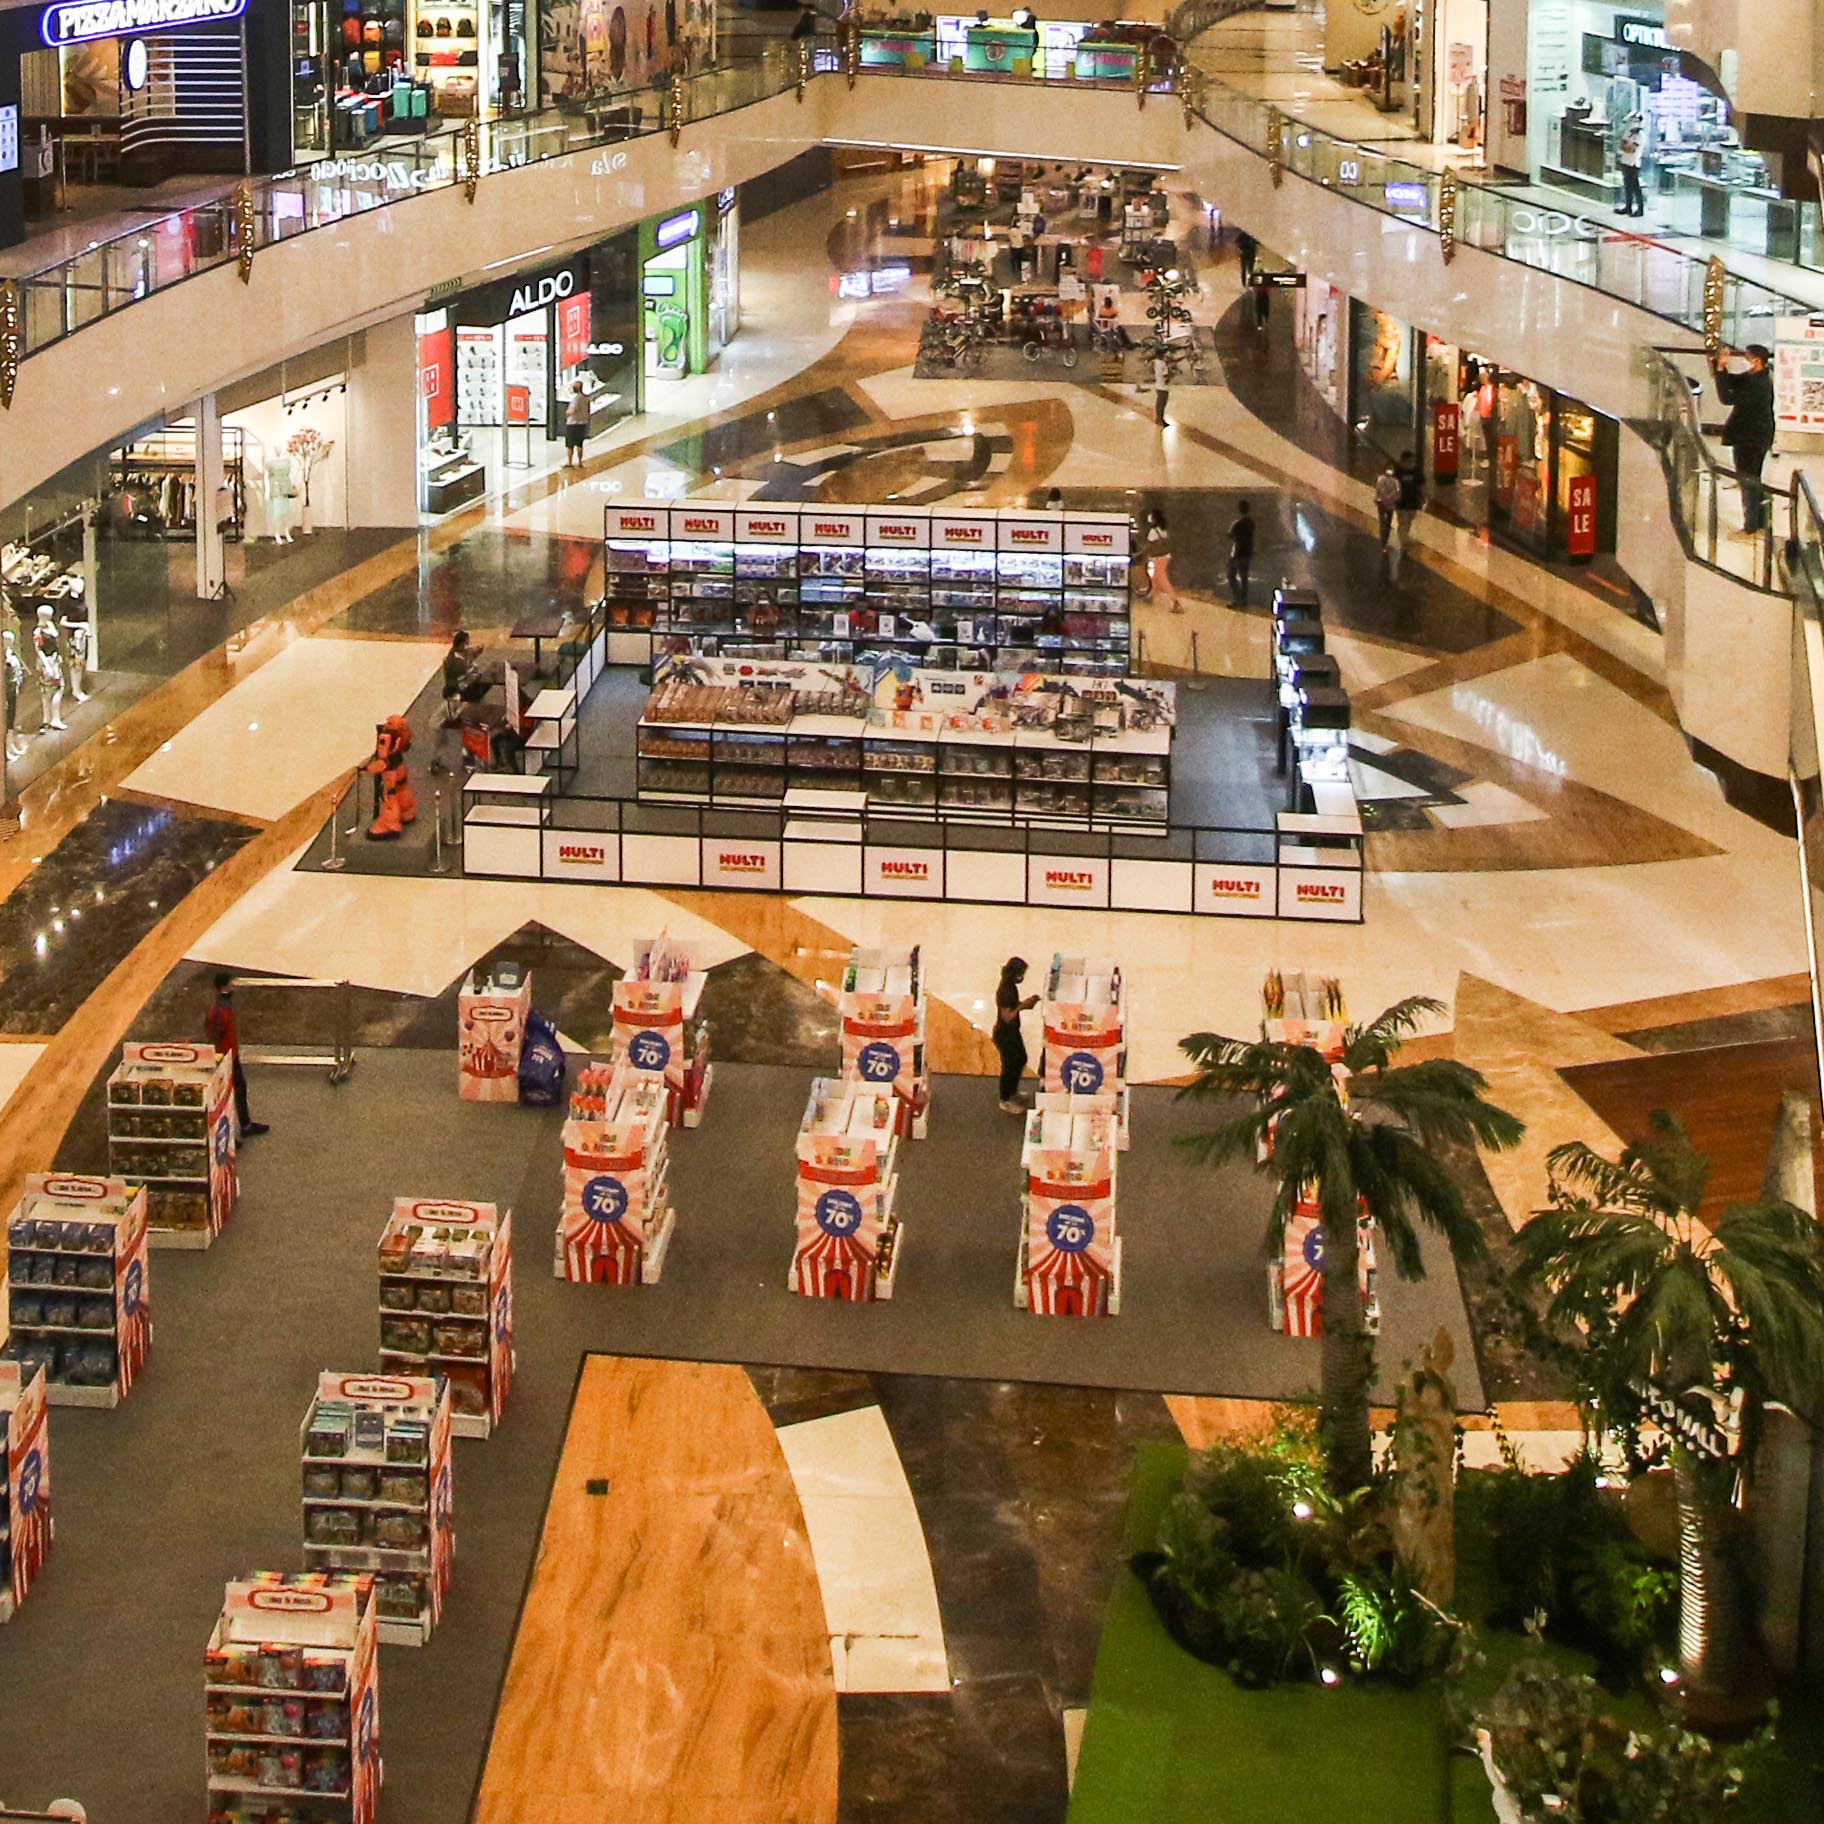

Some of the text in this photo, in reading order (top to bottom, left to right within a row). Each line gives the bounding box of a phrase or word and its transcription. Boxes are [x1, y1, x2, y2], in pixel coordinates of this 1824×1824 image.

[508, 270, 574, 317] ALDO
[1438, 414, 1456, 431] SA
[1439, 436, 1455, 453] LE
[1572, 487, 1592, 508] SA
[620, 516, 655, 527] MULTI
[685, 518, 719, 529] MULTI
[748, 520, 785, 532] MULTI
[814, 523, 850, 534] MULTI
[1573, 514, 1591, 534] LE
[879, 525, 917, 536] MULTI
[945, 527, 982, 538] MULTI
[1011, 529, 1049, 540] MULTI
[1081, 533, 1113, 543] MULTI
[559, 845, 605, 860] MULTI
[719, 853, 766, 868] MULTI
[880, 861, 929, 875] MULTI
[1045, 870, 1094, 885] MULTI
[1212, 879, 1261, 893] MULTI
[1296, 884, 1345, 898] MULTI
